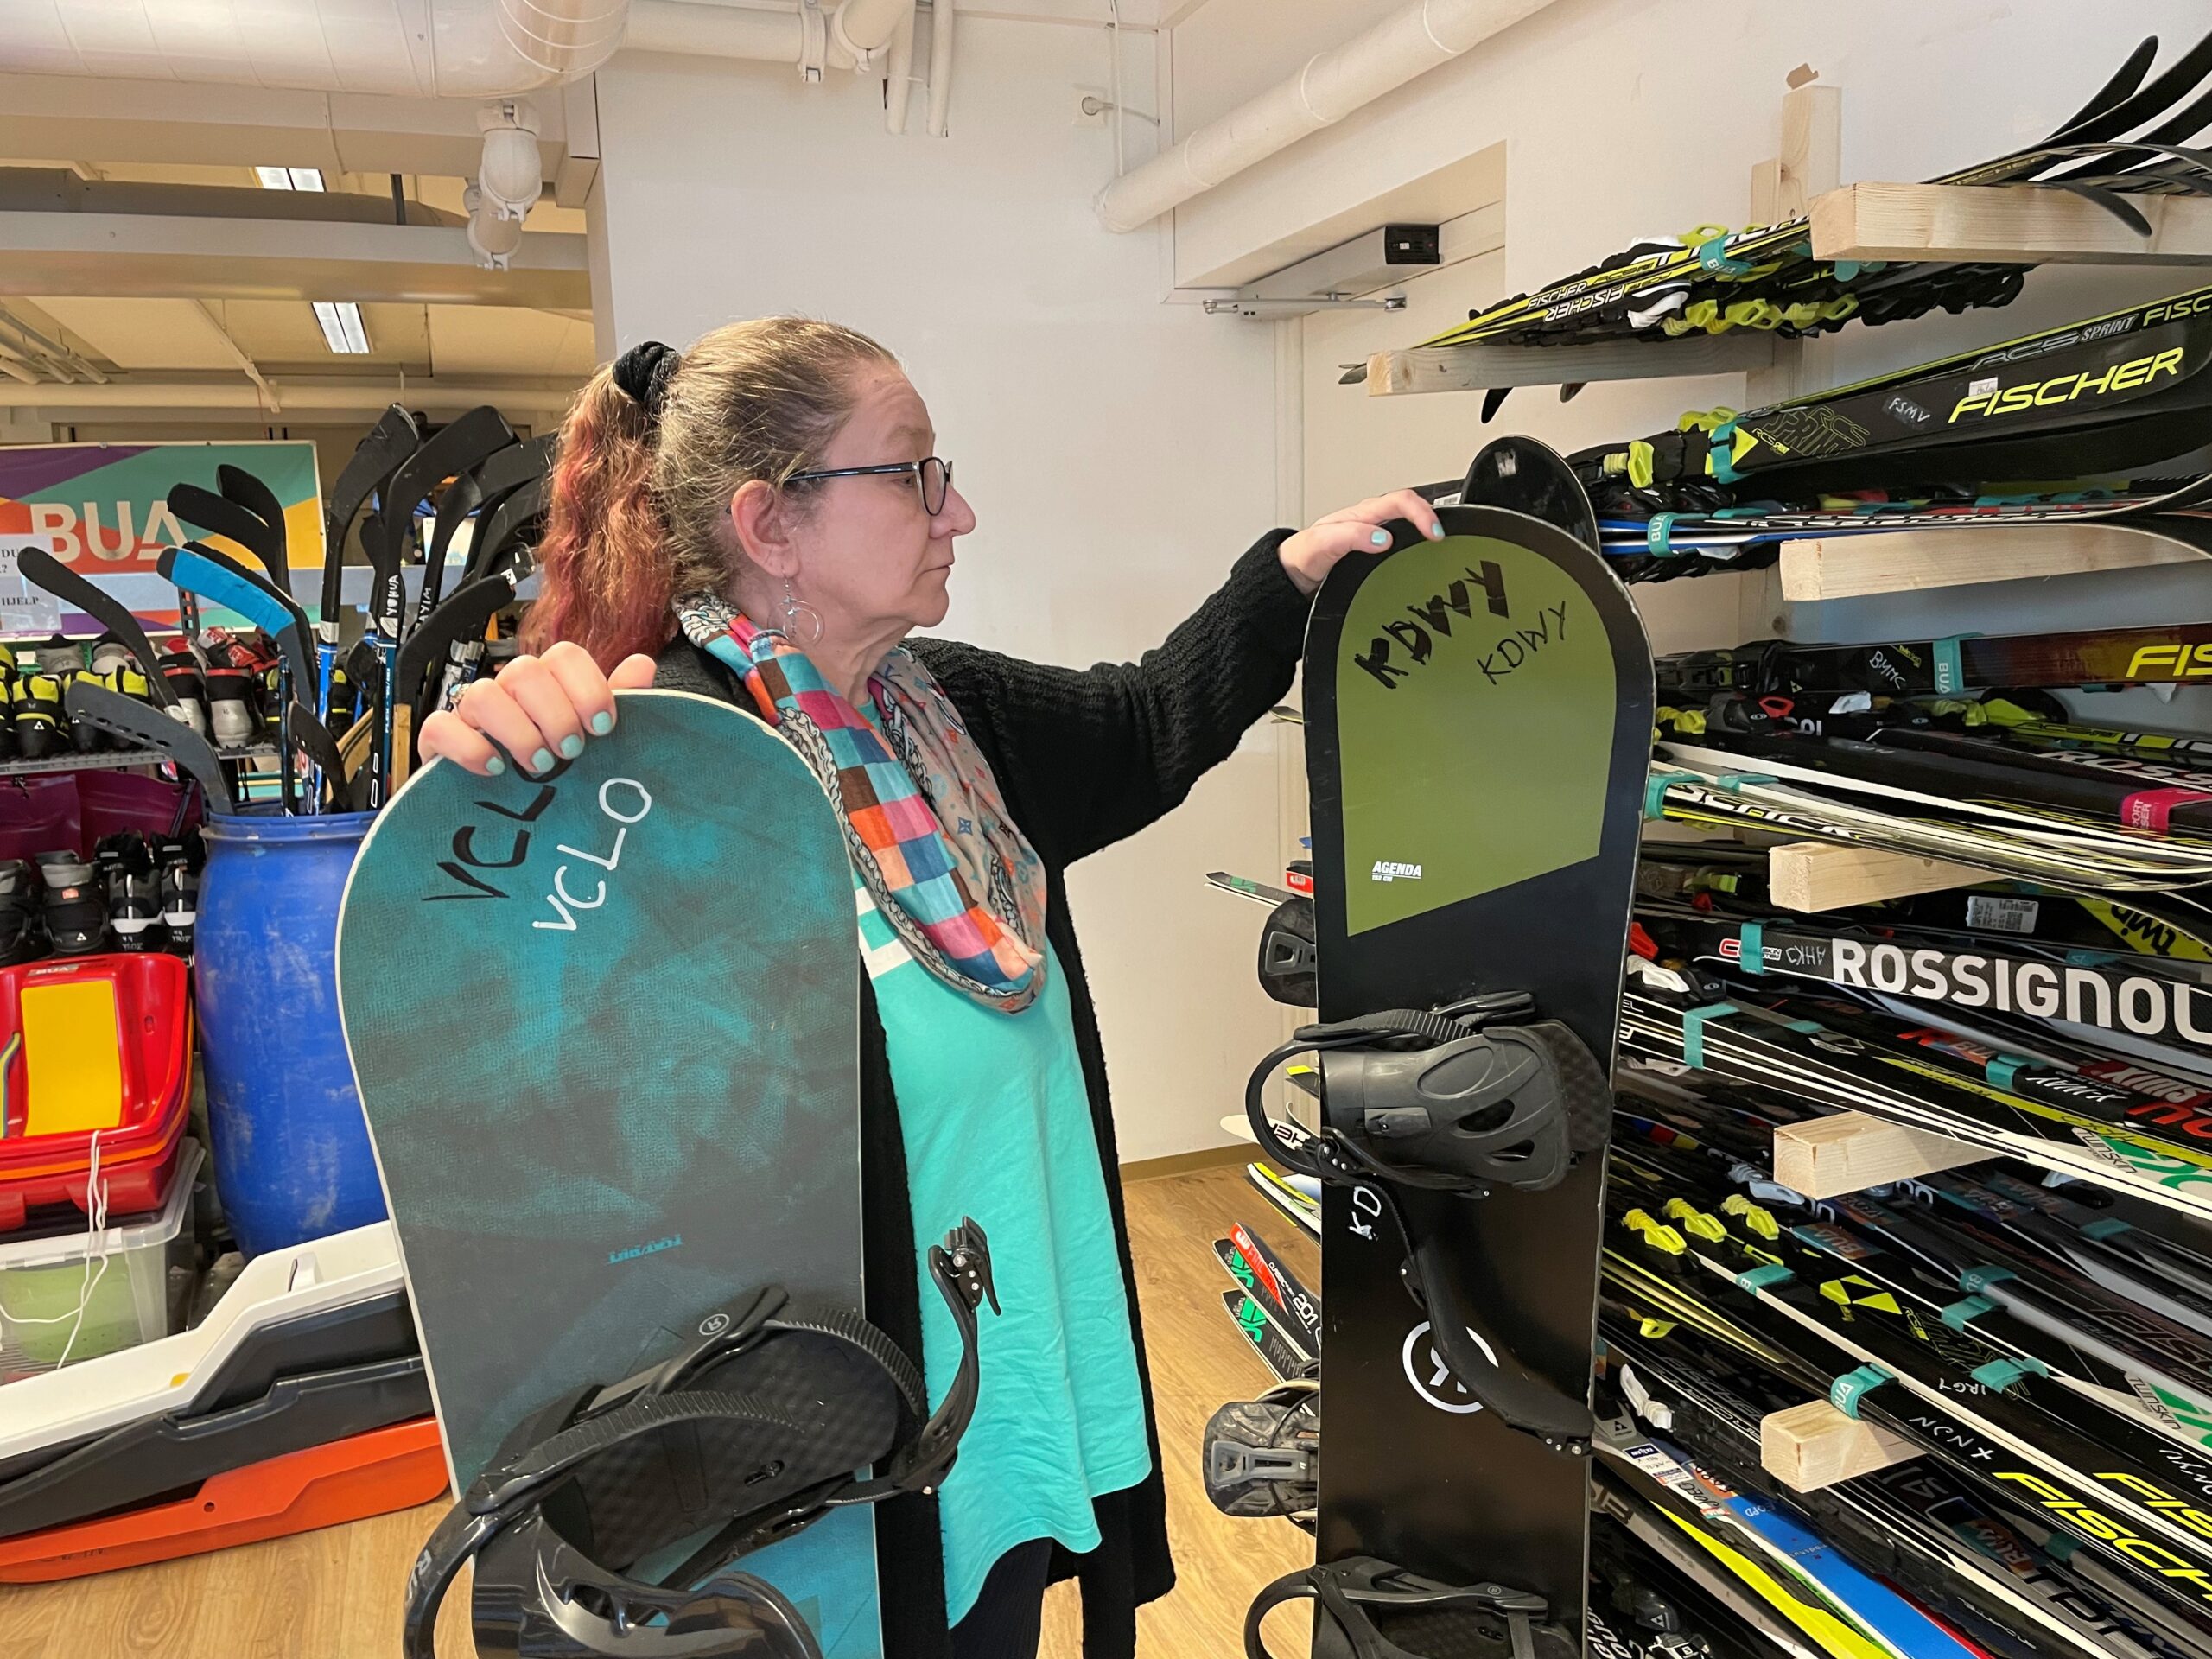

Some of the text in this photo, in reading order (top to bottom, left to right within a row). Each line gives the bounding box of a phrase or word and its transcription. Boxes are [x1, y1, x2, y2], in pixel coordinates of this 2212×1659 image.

[1707, 259, 1734, 273] BUA
[1527, 283, 1587, 309] FISCHER
[1543, 284, 1625, 322] FISCHER
[2081, 314, 2139, 342] SPRINT
[2143, 296, 2212, 327] FISC
[1948, 346, 2183, 424] FISCHER
[30, 500, 187, 563] BUA
[1650, 515, 1668, 543] BUA
[1477, 600, 1566, 685] KDWY
[532, 778, 652, 931] VCLO
[1372, 861, 1422, 877] AGENDA
[1831, 938, 2212, 1046] ROSSIGNOL
[1815, 1228, 1863, 1255] BUA
[1293, 1293, 1319, 1325] 201
[1835, 1382, 1854, 1413] BUA
[2131, 1377, 2182, 1430] TWINSKIN
